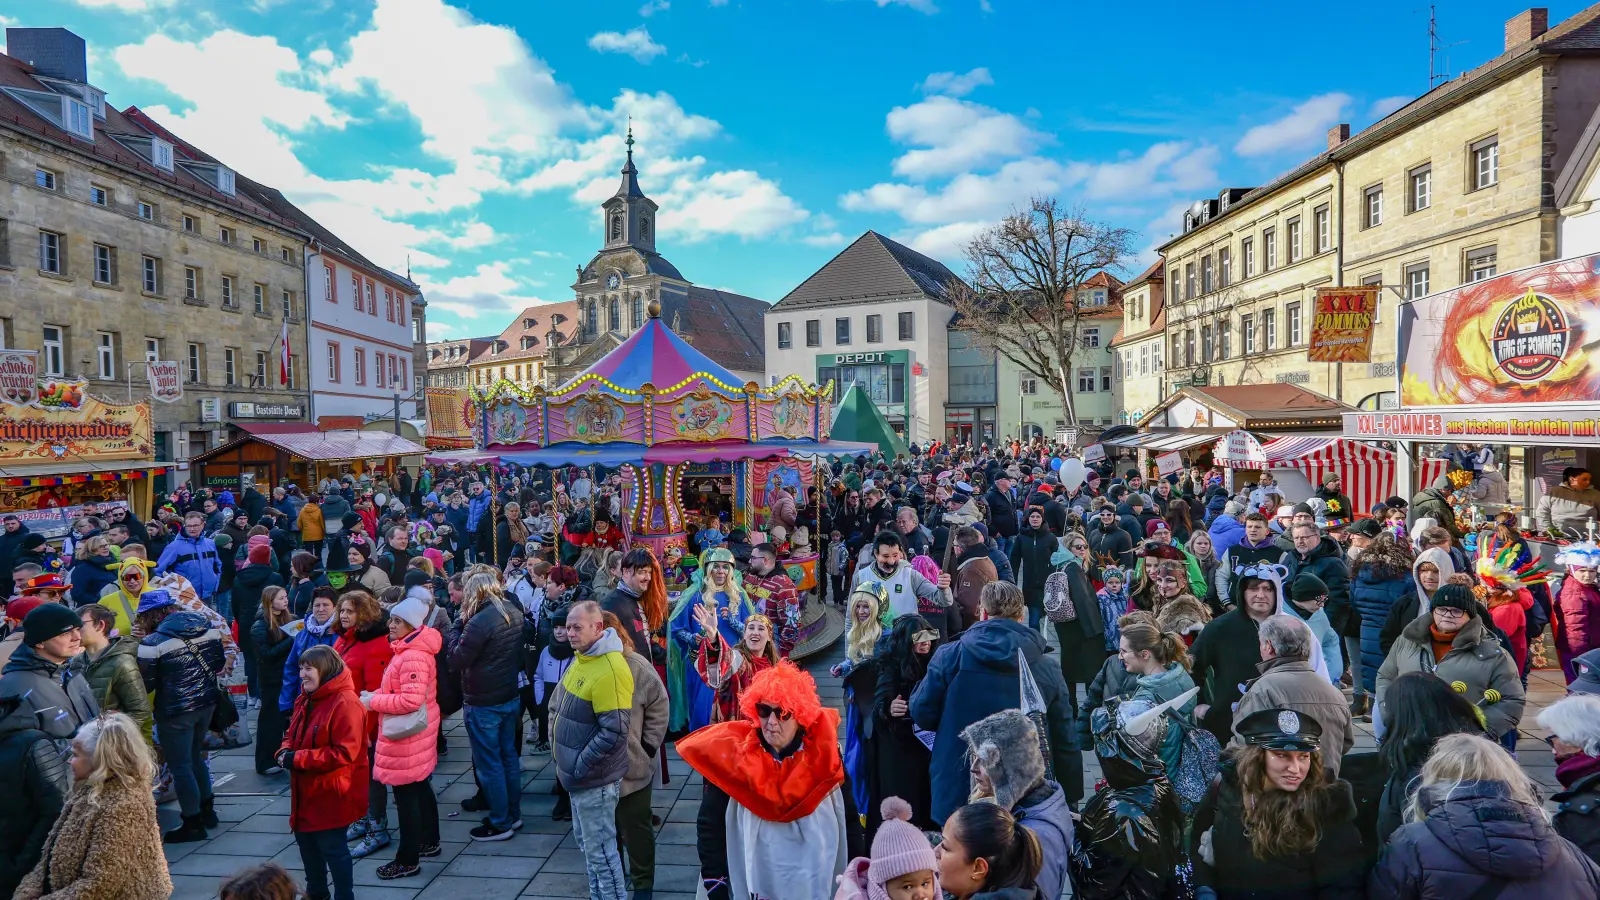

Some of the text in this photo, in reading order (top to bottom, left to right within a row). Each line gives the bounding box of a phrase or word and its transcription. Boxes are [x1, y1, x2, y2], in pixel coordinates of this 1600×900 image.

[1320, 295, 1366, 312] XXL
[1314, 312, 1371, 330] POMMES
[1498, 333, 1561, 363] KING OF POMMES
[836, 352, 885, 363] DEPOT
[151, 365, 177, 376] Liebes
[157, 376, 177, 388] äpfel
[256, 404, 283, 415] Gaststätte
[0, 418, 132, 443] üchteparadies
[1357, 413, 1443, 436] XXL-POMMES
[1446, 421, 1464, 434] aus
[1465, 419, 1508, 435] frischen
[1510, 418, 1570, 436] Kartoffeln
[1572, 418, 1596, 436] mit
[207, 477, 238, 486] Lángos
